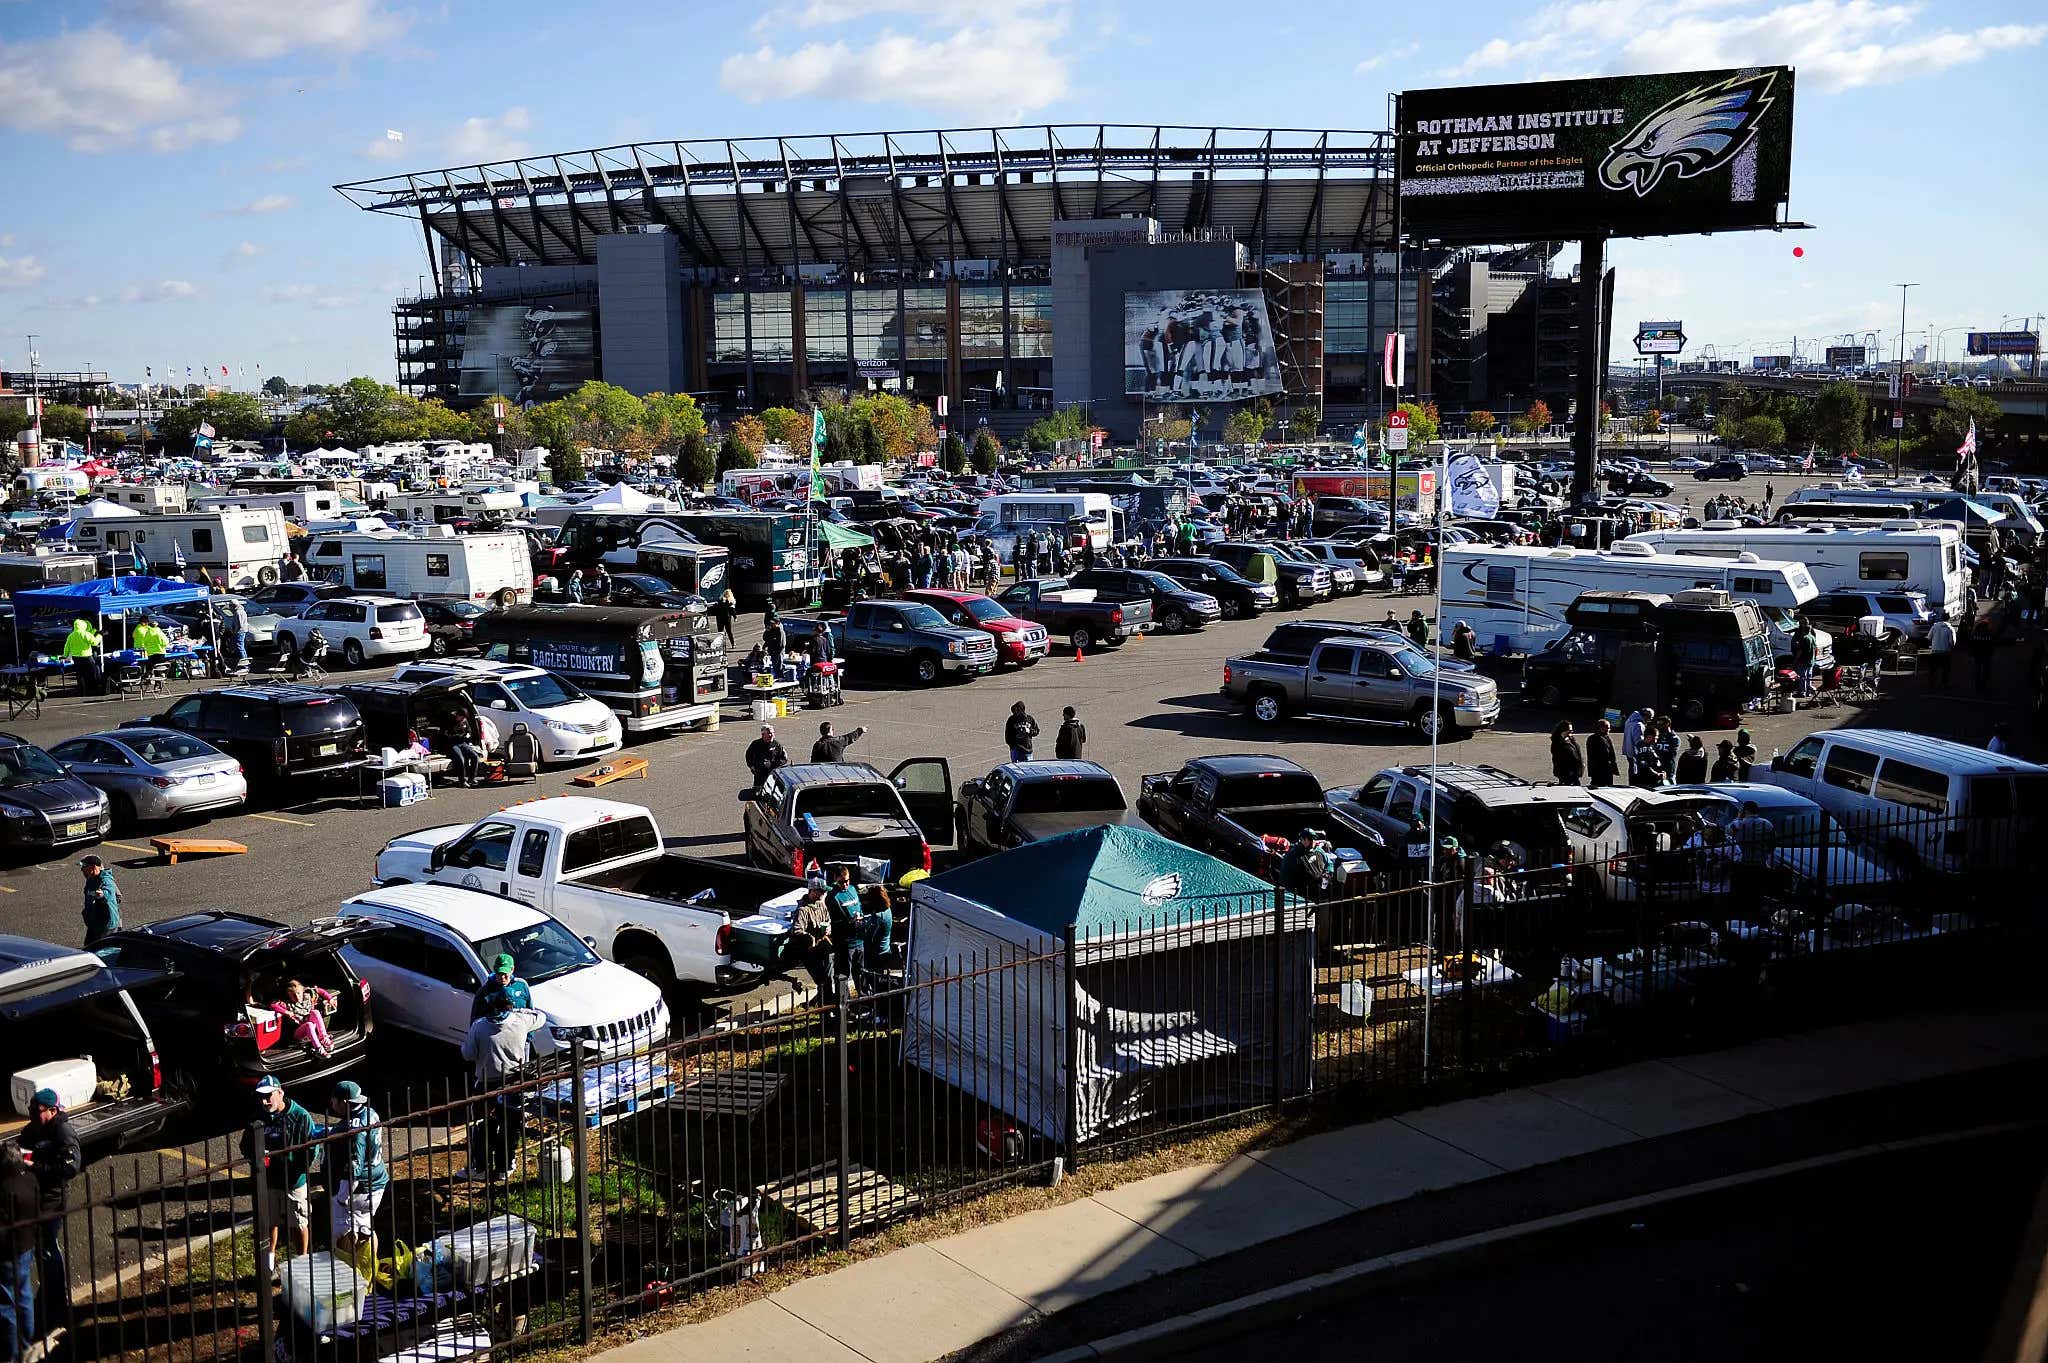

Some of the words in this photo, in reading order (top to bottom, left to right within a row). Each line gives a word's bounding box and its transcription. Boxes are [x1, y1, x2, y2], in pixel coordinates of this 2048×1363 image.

[1417, 115, 1513, 134] ROTHMAN
[1518, 109, 1624, 129] INSTITUTE
[1416, 140, 1441, 156] AT
[1447, 133, 1555, 154] JEFFERSON
[1415, 164, 1446, 172] Official
[1447, 161, 1494, 170] Orthopedic
[1497, 159, 1527, 168] Partner
[1529, 158, 1538, 166] of
[1556, 156, 1583, 166] Eagles
[1391, 415, 1406, 426] D6
[532, 649, 568, 668] EAGLES
[570, 654, 614, 671] COUNTRY
